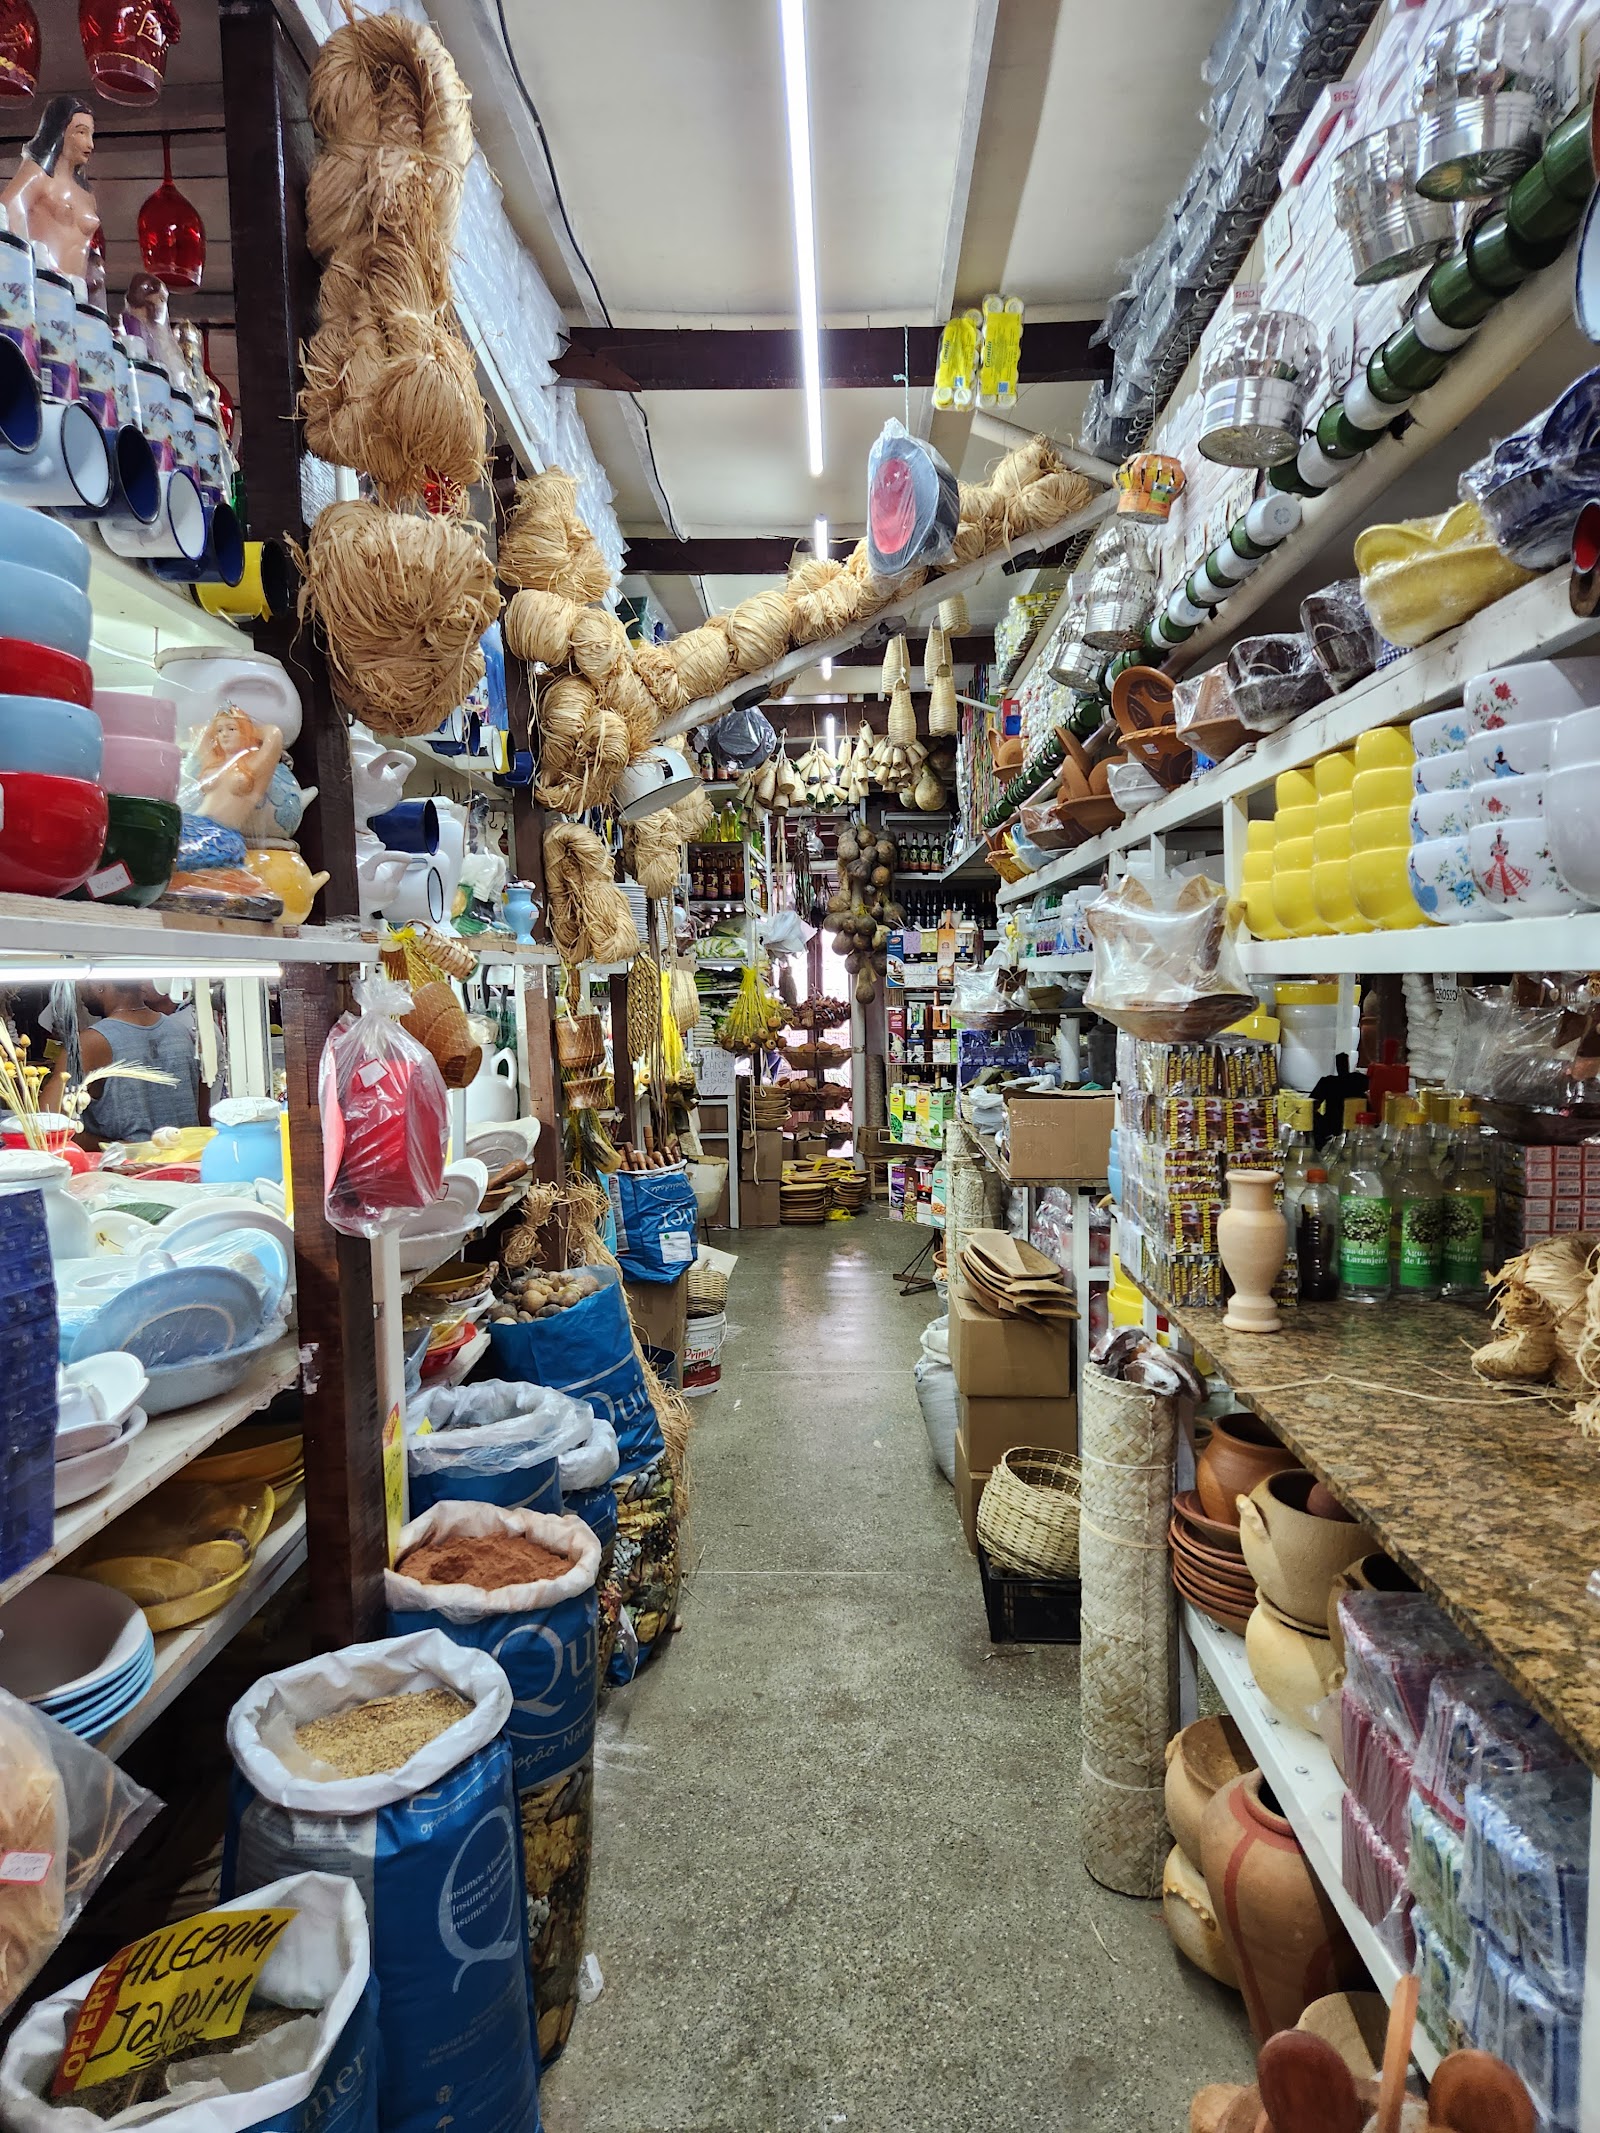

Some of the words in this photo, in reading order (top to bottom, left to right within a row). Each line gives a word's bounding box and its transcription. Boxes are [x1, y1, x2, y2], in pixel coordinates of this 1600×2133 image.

[1266, 228, 1289, 262] AZUL
[1346, 1254, 1388, 1266] Laranjeira
[1404, 1246, 1427, 1258] Água
[684, 1347, 715, 1360] Primor
[446, 1873, 485, 1903] Insumos
[452, 1886, 490, 1916] Insumos
[450, 1902, 488, 1933] Insumos
[63, 1951, 131, 2078] OFERTA
